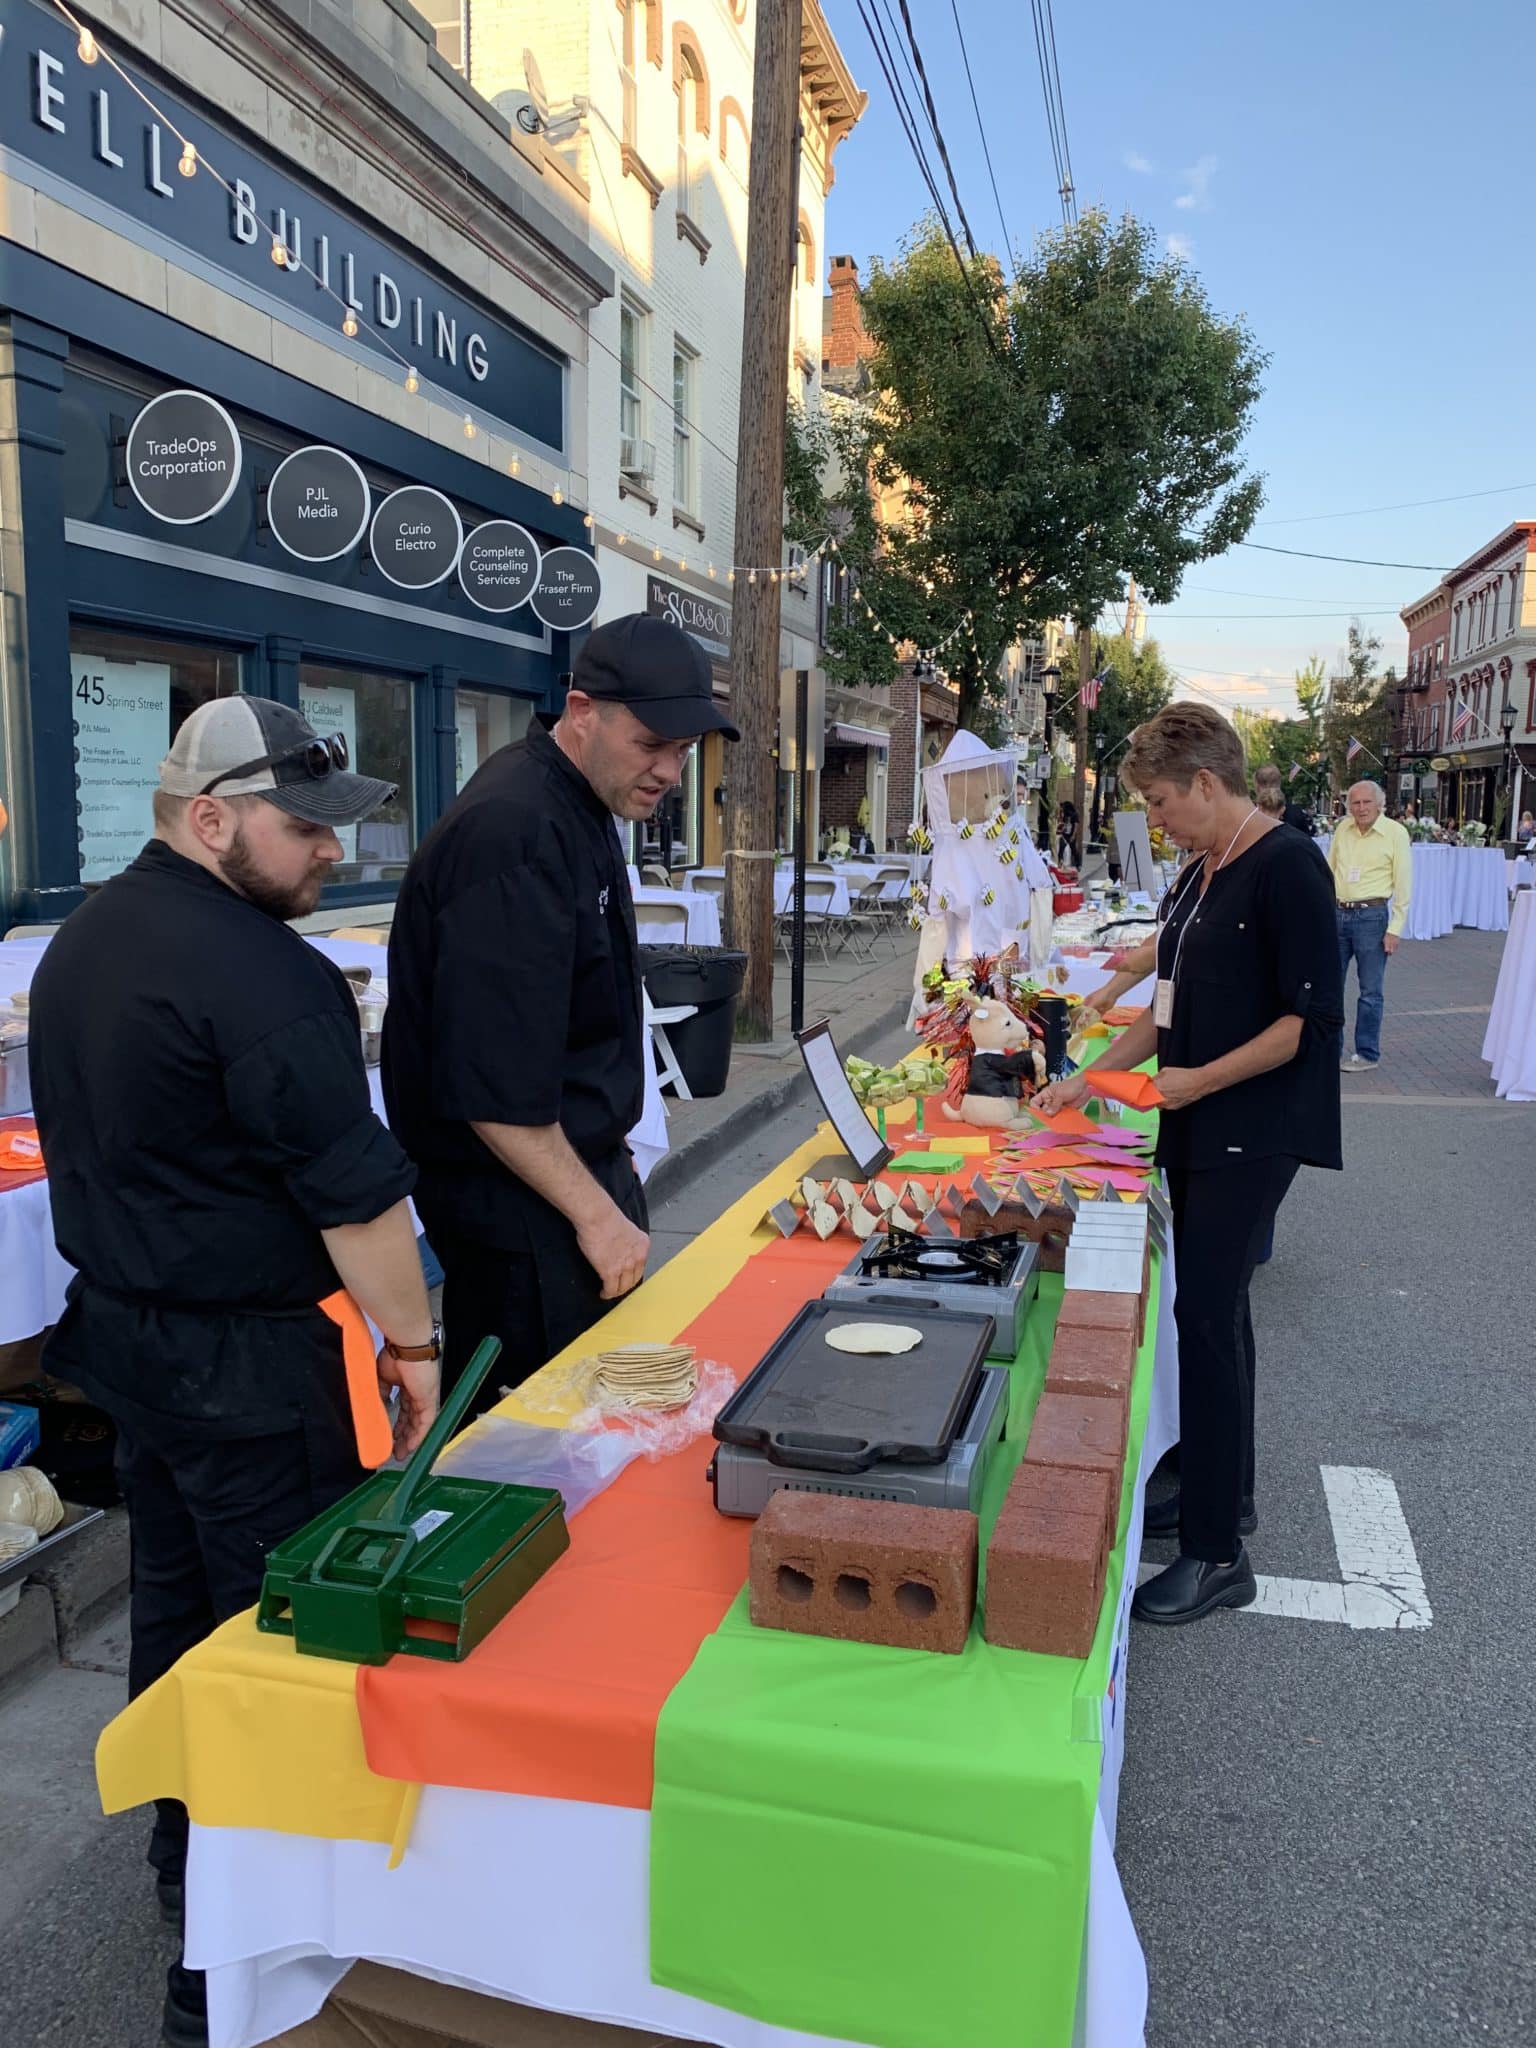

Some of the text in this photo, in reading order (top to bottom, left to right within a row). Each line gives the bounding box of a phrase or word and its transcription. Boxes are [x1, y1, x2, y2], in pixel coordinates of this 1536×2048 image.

[0, 24, 489, 381] ELL BUILDING
[145, 437, 217, 457] TradeOps
[139, 457, 226, 480] Corporation
[306, 487, 330, 501] PJL
[298, 504, 338, 519] Media
[399, 522, 432, 536] Curio
[395, 538, 437, 551] Electro
[472, 546, 526, 560] Complete
[469, 560, 529, 574] Counseling
[477, 573, 521, 585] Services
[556, 570, 575, 581] The
[538, 583, 593, 594] Fraser Firm
[653, 584, 668, 605] The
[559, 598, 573, 607] LLC
[76, 674, 164, 711] 45 Spring Street
